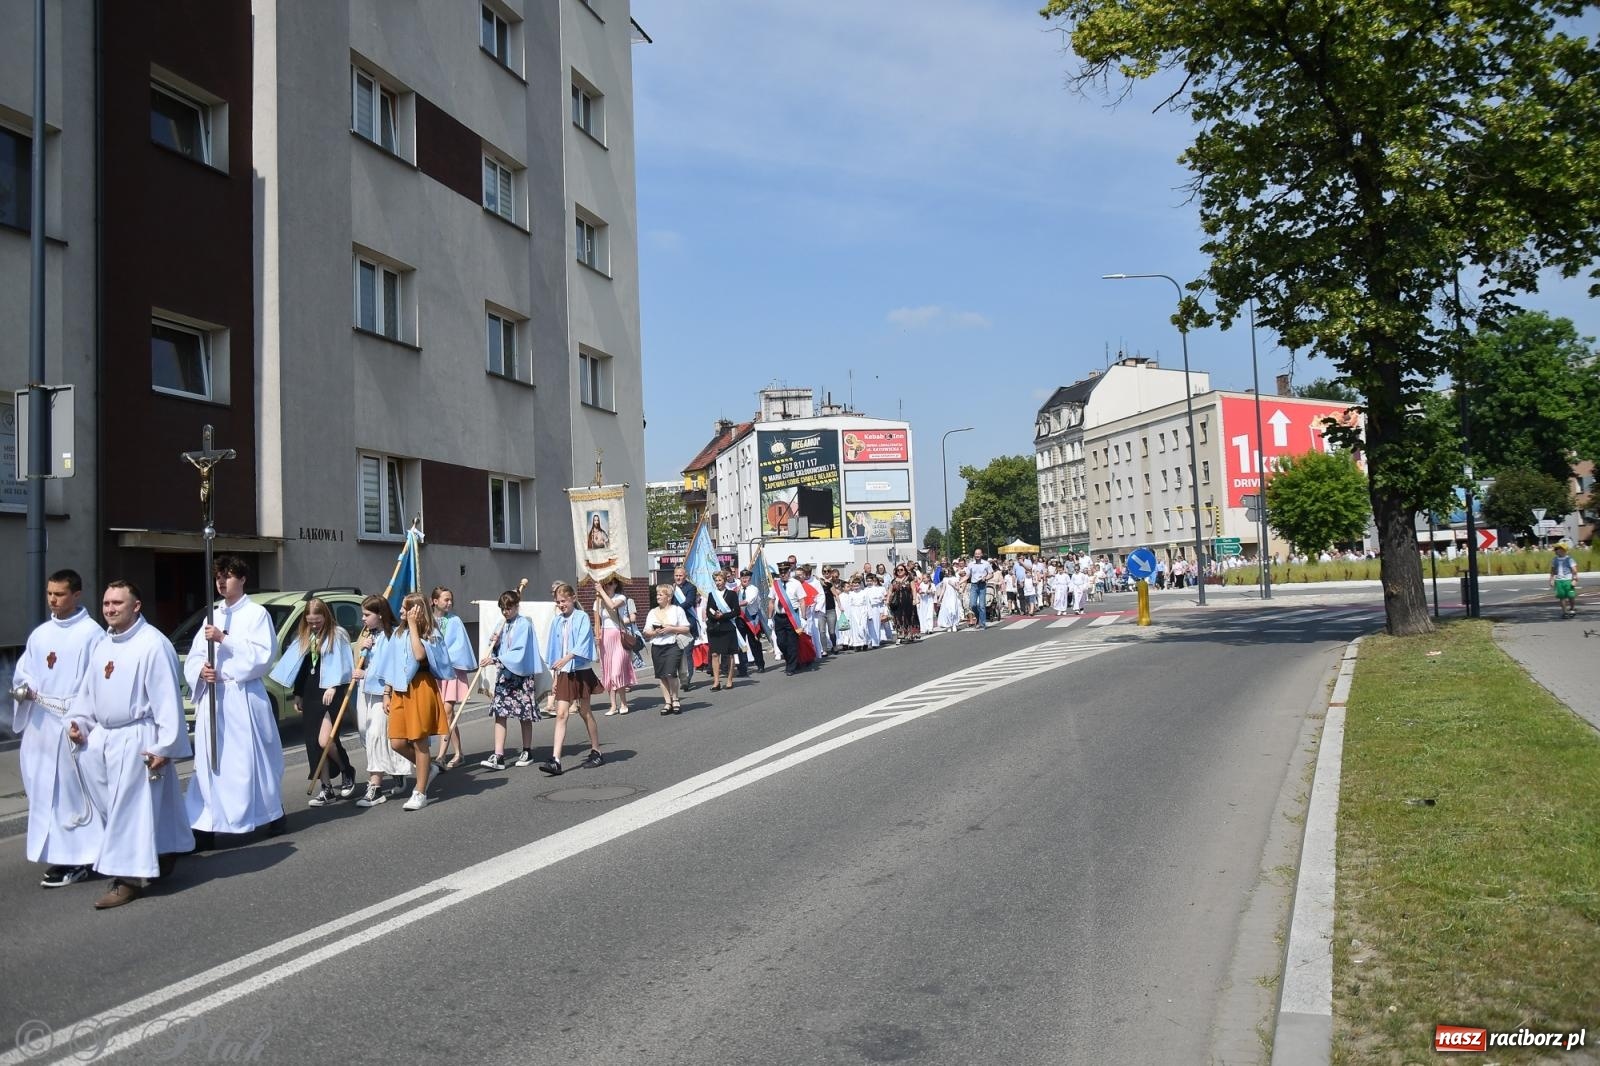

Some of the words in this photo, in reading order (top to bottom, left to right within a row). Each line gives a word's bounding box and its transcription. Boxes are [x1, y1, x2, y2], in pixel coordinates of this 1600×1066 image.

[1231, 434, 1250, 473] 1
[781, 463, 793, 472] 797
[793, 460, 805, 470] 817
[806, 458, 818, 467] 117
[1234, 479, 1265, 488] DRIV
